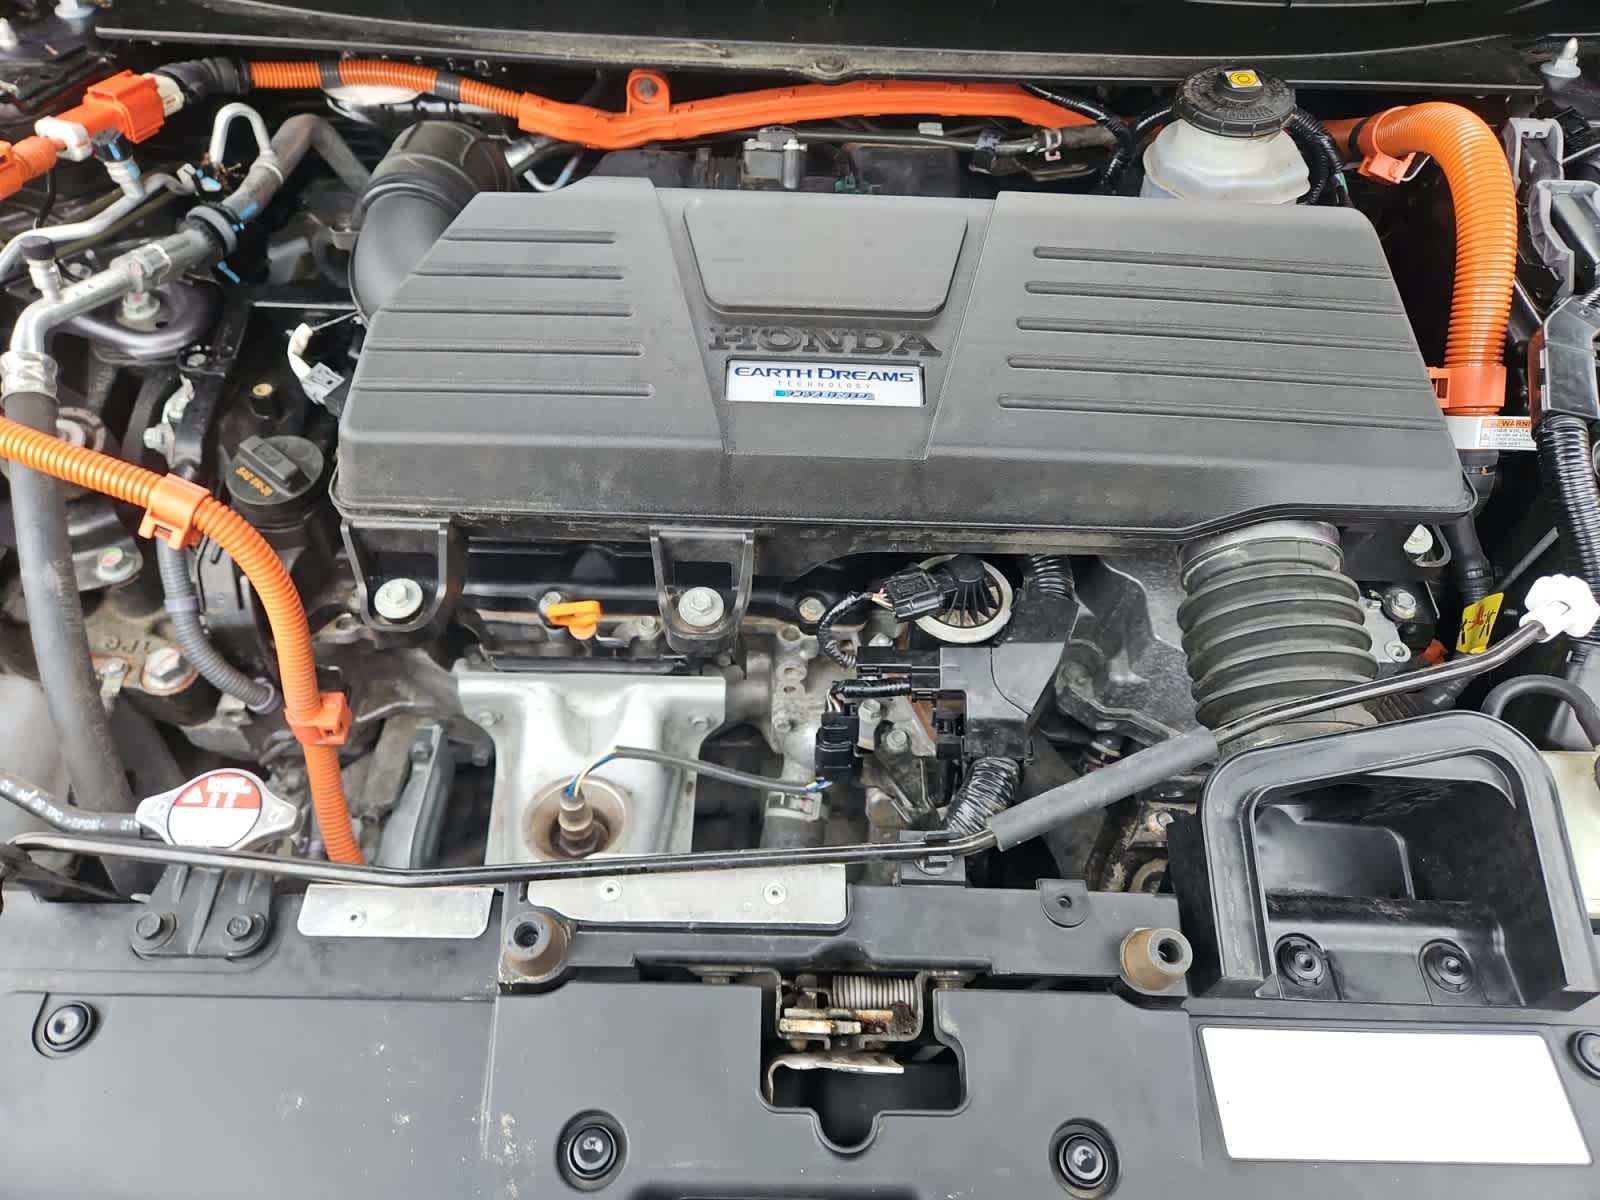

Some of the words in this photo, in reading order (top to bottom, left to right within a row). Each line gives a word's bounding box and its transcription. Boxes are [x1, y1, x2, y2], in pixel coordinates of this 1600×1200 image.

[708, 327, 943, 357] HONDA
[734, 366, 812, 379] EARTH
[817, 367, 914, 383] DREAMS
[777, 380, 872, 389] TECHNOLOGY
[1502, 419, 1531, 427] WARN
